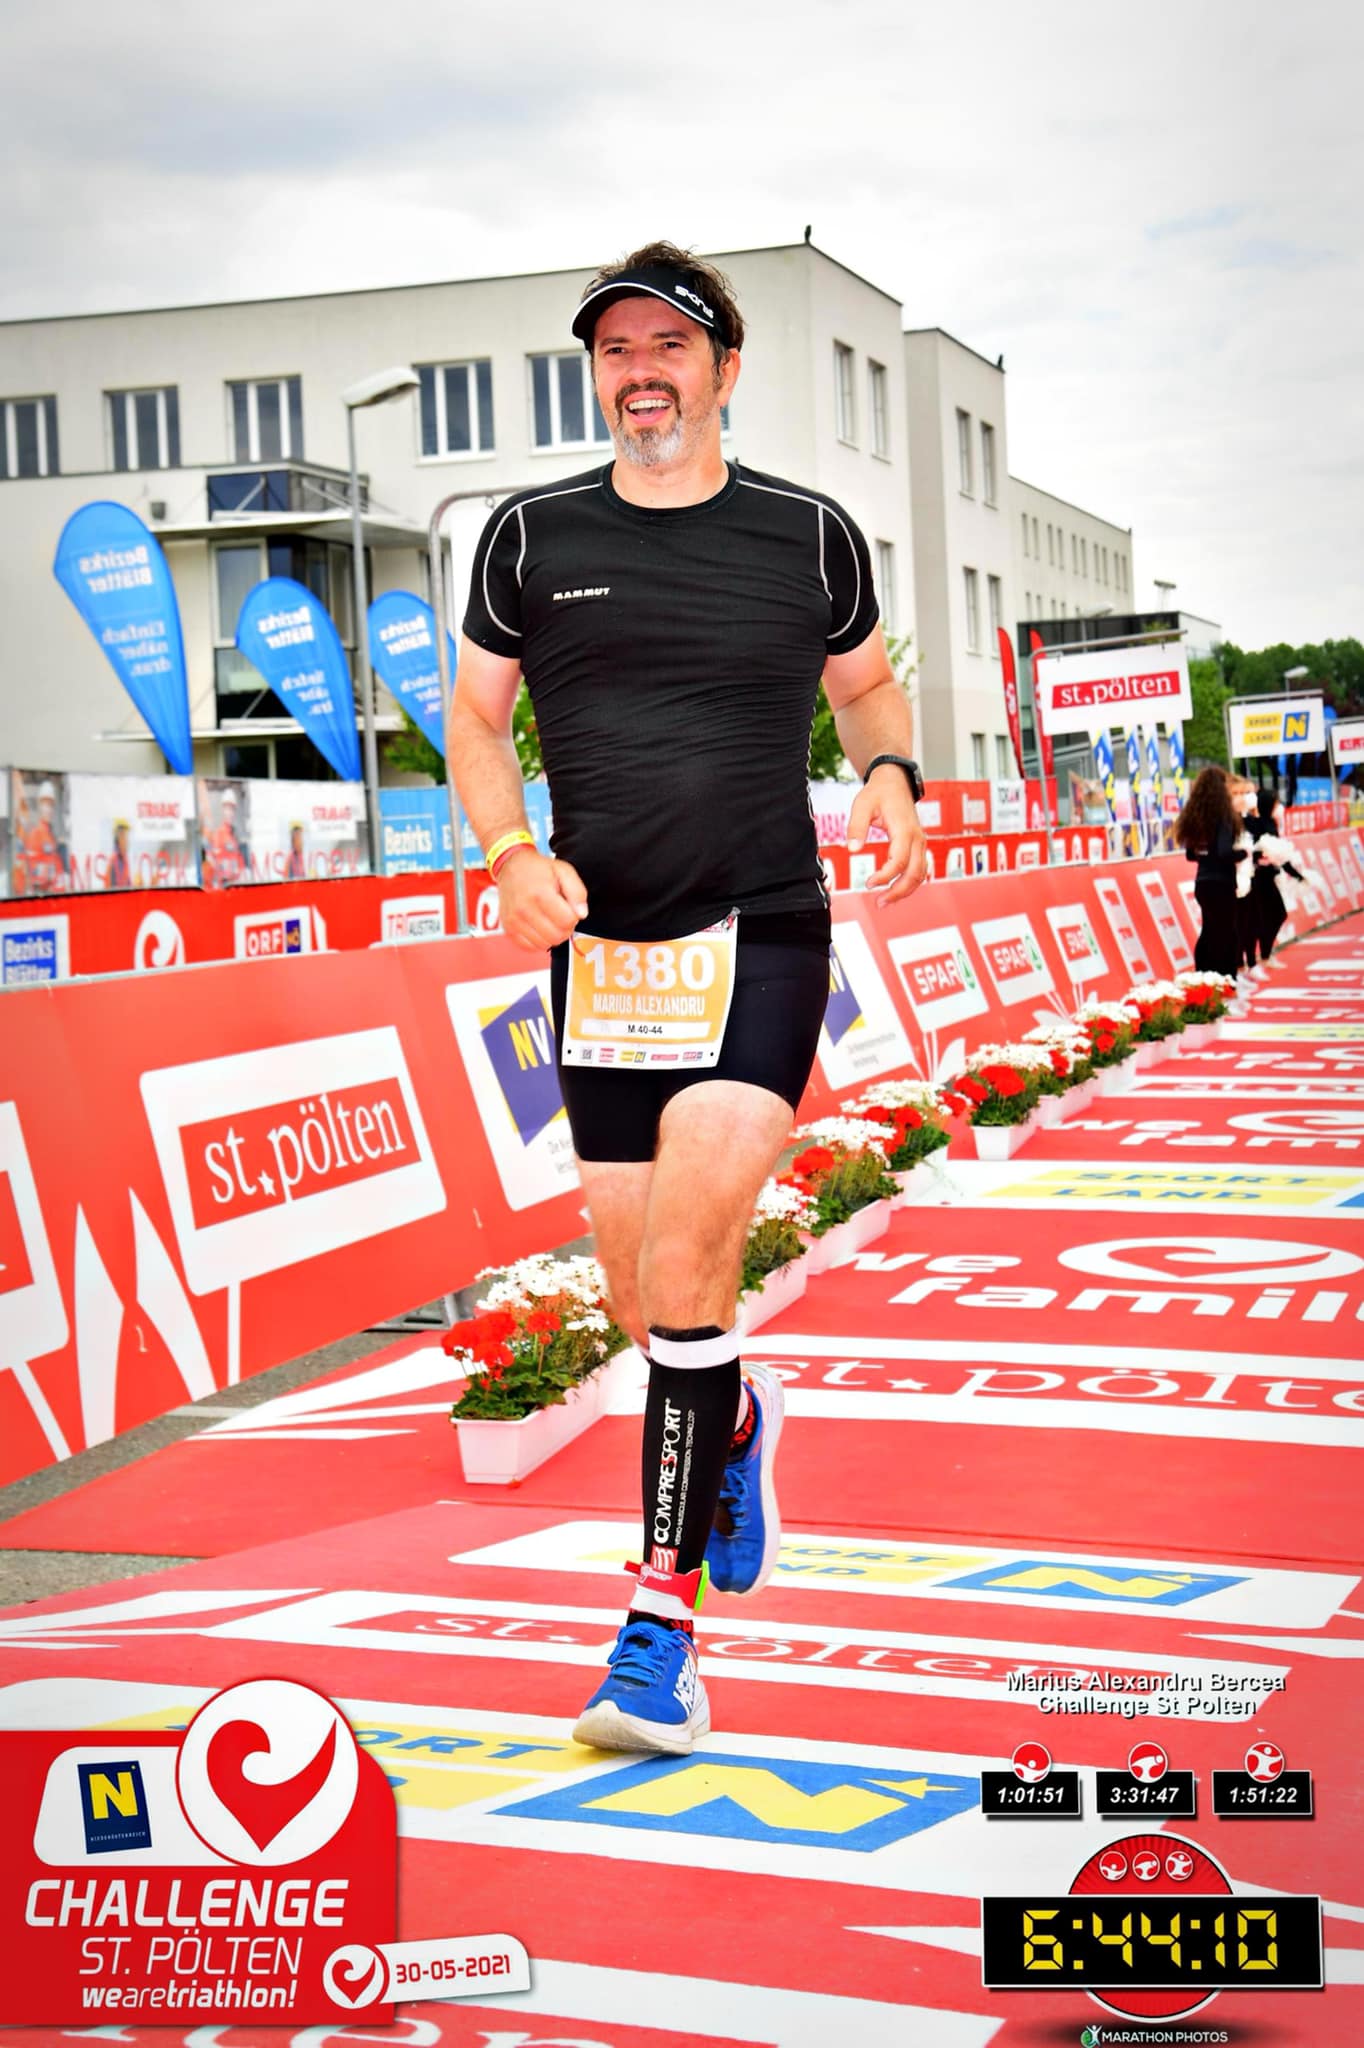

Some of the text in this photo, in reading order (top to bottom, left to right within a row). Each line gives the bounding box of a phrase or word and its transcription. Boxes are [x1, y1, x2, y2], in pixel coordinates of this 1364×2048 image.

[552, 586, 611, 601] MAMMUT
[1060, 676, 1172, 705] st.pölten
[384, 824, 432, 856] Bezirks
[6, 937, 54, 963] Bezirks
[247, 928, 282, 956] ORF
[584, 943, 716, 991] 1380
[994, 943, 1031, 973] SPAR
[913, 959, 963, 996] SPAR
[592, 992, 705, 1017] MARIUS ALEXANDRU
[507, 1015, 553, 1071] NV
[627, 1025, 663, 1035] M 40-44
[1073, 1172, 1326, 1184] SPORT
[1050, 1188, 1262, 1200] LAND
[838, 1250, 1023, 1274] we
[887, 1276, 1364, 1323] famil
[356, 1728, 567, 1761] ORT
